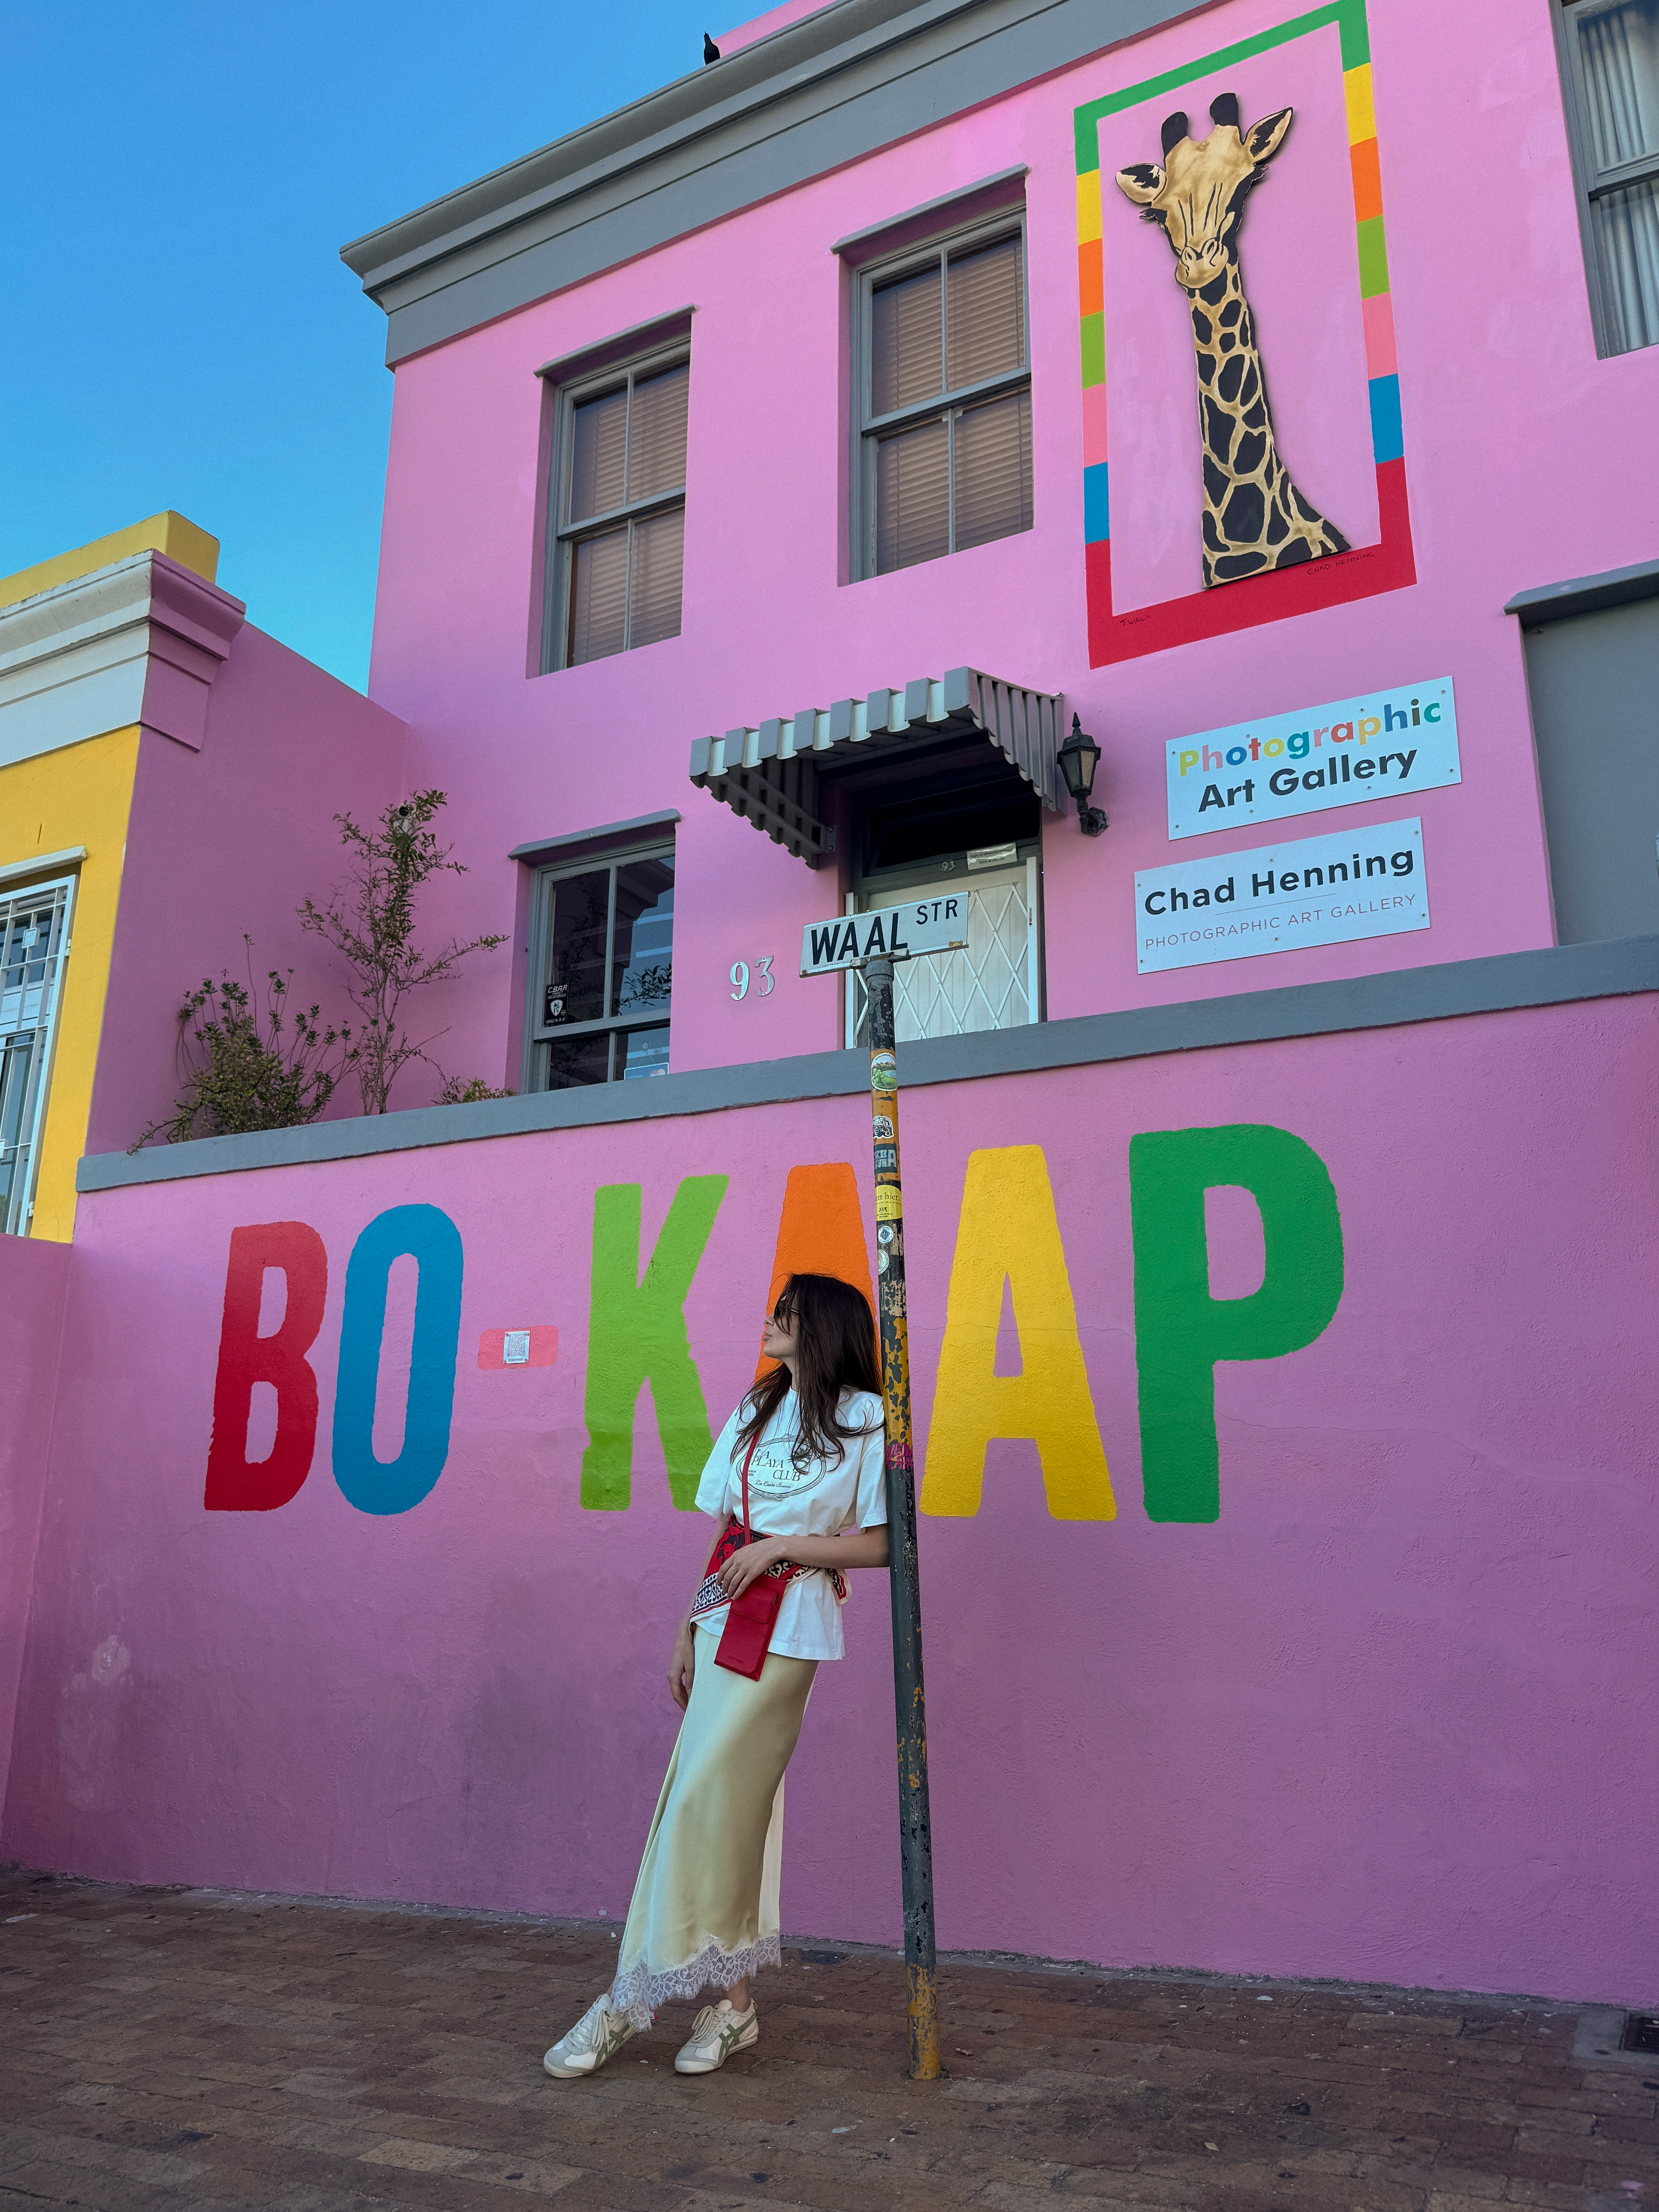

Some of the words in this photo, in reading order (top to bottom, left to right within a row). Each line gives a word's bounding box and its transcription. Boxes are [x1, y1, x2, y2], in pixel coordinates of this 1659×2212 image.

[1307, 564, 1331, 575] CHAD
[1335, 552, 1374, 567] HENNING
[1119, 615, 1150, 627] TWALA
[1179, 699, 1441, 777] Photographic
[1198, 778, 1255, 813] Art
[1269, 749, 1417, 796] Gallery
[941, 860, 955, 872] 93
[1144, 877, 1235, 915] Chad
[1252, 849, 1414, 898] Henning
[811, 912, 908, 965] WAAL
[916, 899, 958, 925] STR
[1145, 917, 1280, 950] PHOTOGRAPHIC
[1288, 910, 1323, 925] ART
[1331, 893, 1417, 918] GALLERY
[730, 955, 774, 1001] 93
[751, 1456, 784, 1468] PLAYA
[755, 1449, 770, 1459] LA
[773, 1469, 801, 1481] CLUB
